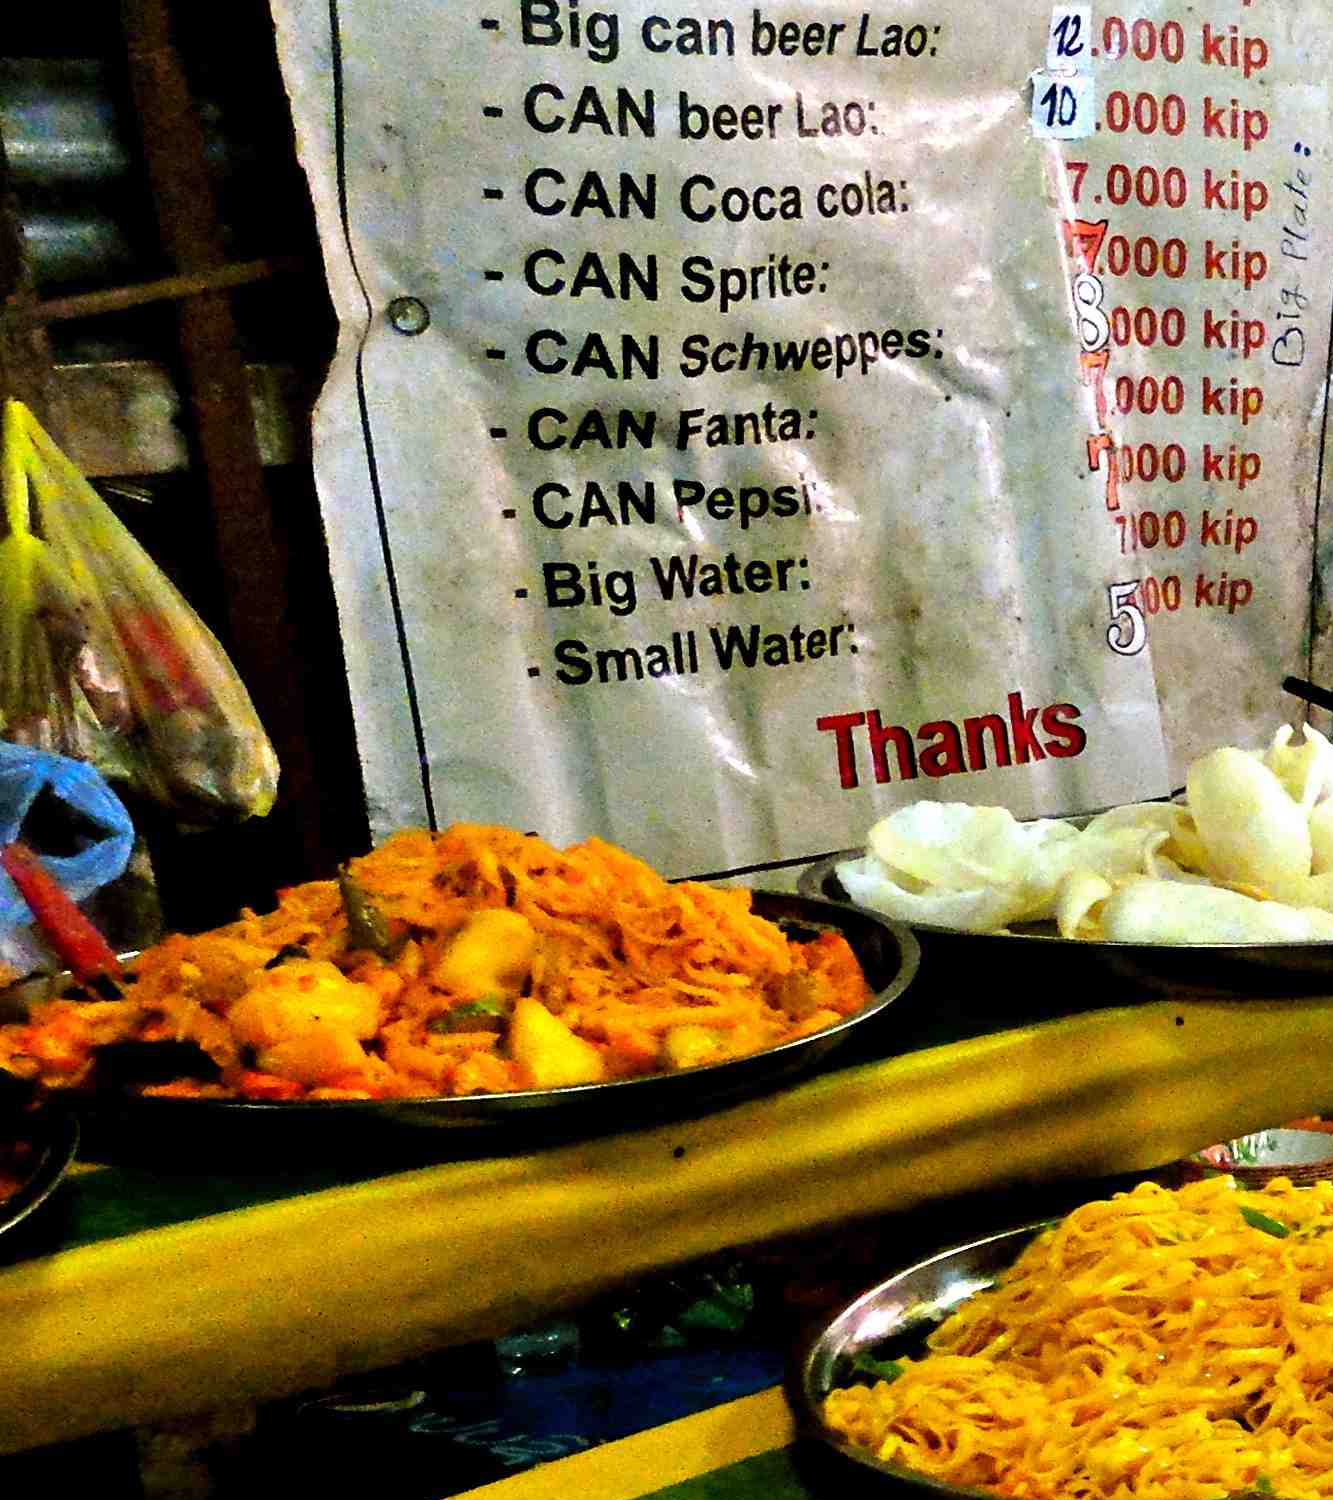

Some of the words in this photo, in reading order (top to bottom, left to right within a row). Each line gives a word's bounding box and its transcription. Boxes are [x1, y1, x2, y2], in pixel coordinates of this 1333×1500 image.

[521, 0, 619, 62] Big
[643, 15, 735, 56] can
[752, 9, 845, 56] beer
[857, 14, 942, 57] Lao:
[1202, 23, 1269, 78] kip
[524, 84, 655, 138] CAN
[681, 92, 781, 139] beer
[797, 94, 880, 137] Lao:
[1204, 96, 1269, 150] kip
[524, 169, 657, 219] CAN
[681, 175, 802, 223] Coca
[816, 171, 910, 216] cola:
[1066, 161, 1187, 209] 7.000
[1204, 170, 1269, 221] kip
[524, 250, 658, 301] CAN
[681, 256, 829, 312] Sprite:
[1204, 241, 1268, 289] kip
[1204, 311, 1266, 357] kip
[1272, 283, 1308, 366] Big
[525, 329, 659, 380] CAN
[680, 326, 943, 378] Schweppes:
[527, 408, 656, 451] CAN
[677, 403, 818, 452] Fanta:
[1202, 377, 1264, 424] kip
[1202, 444, 1261, 489] kip
[532, 482, 655, 529] CAN
[1200, 509, 1258, 554] kip
[543, 562, 636, 616] Big
[651, 553, 809, 602] Water:
[1195, 572, 1253, 614] kip
[555, 630, 698, 686] Small
[711, 623, 858, 671] Water:
[817, 692, 1088, 790] Thanks
